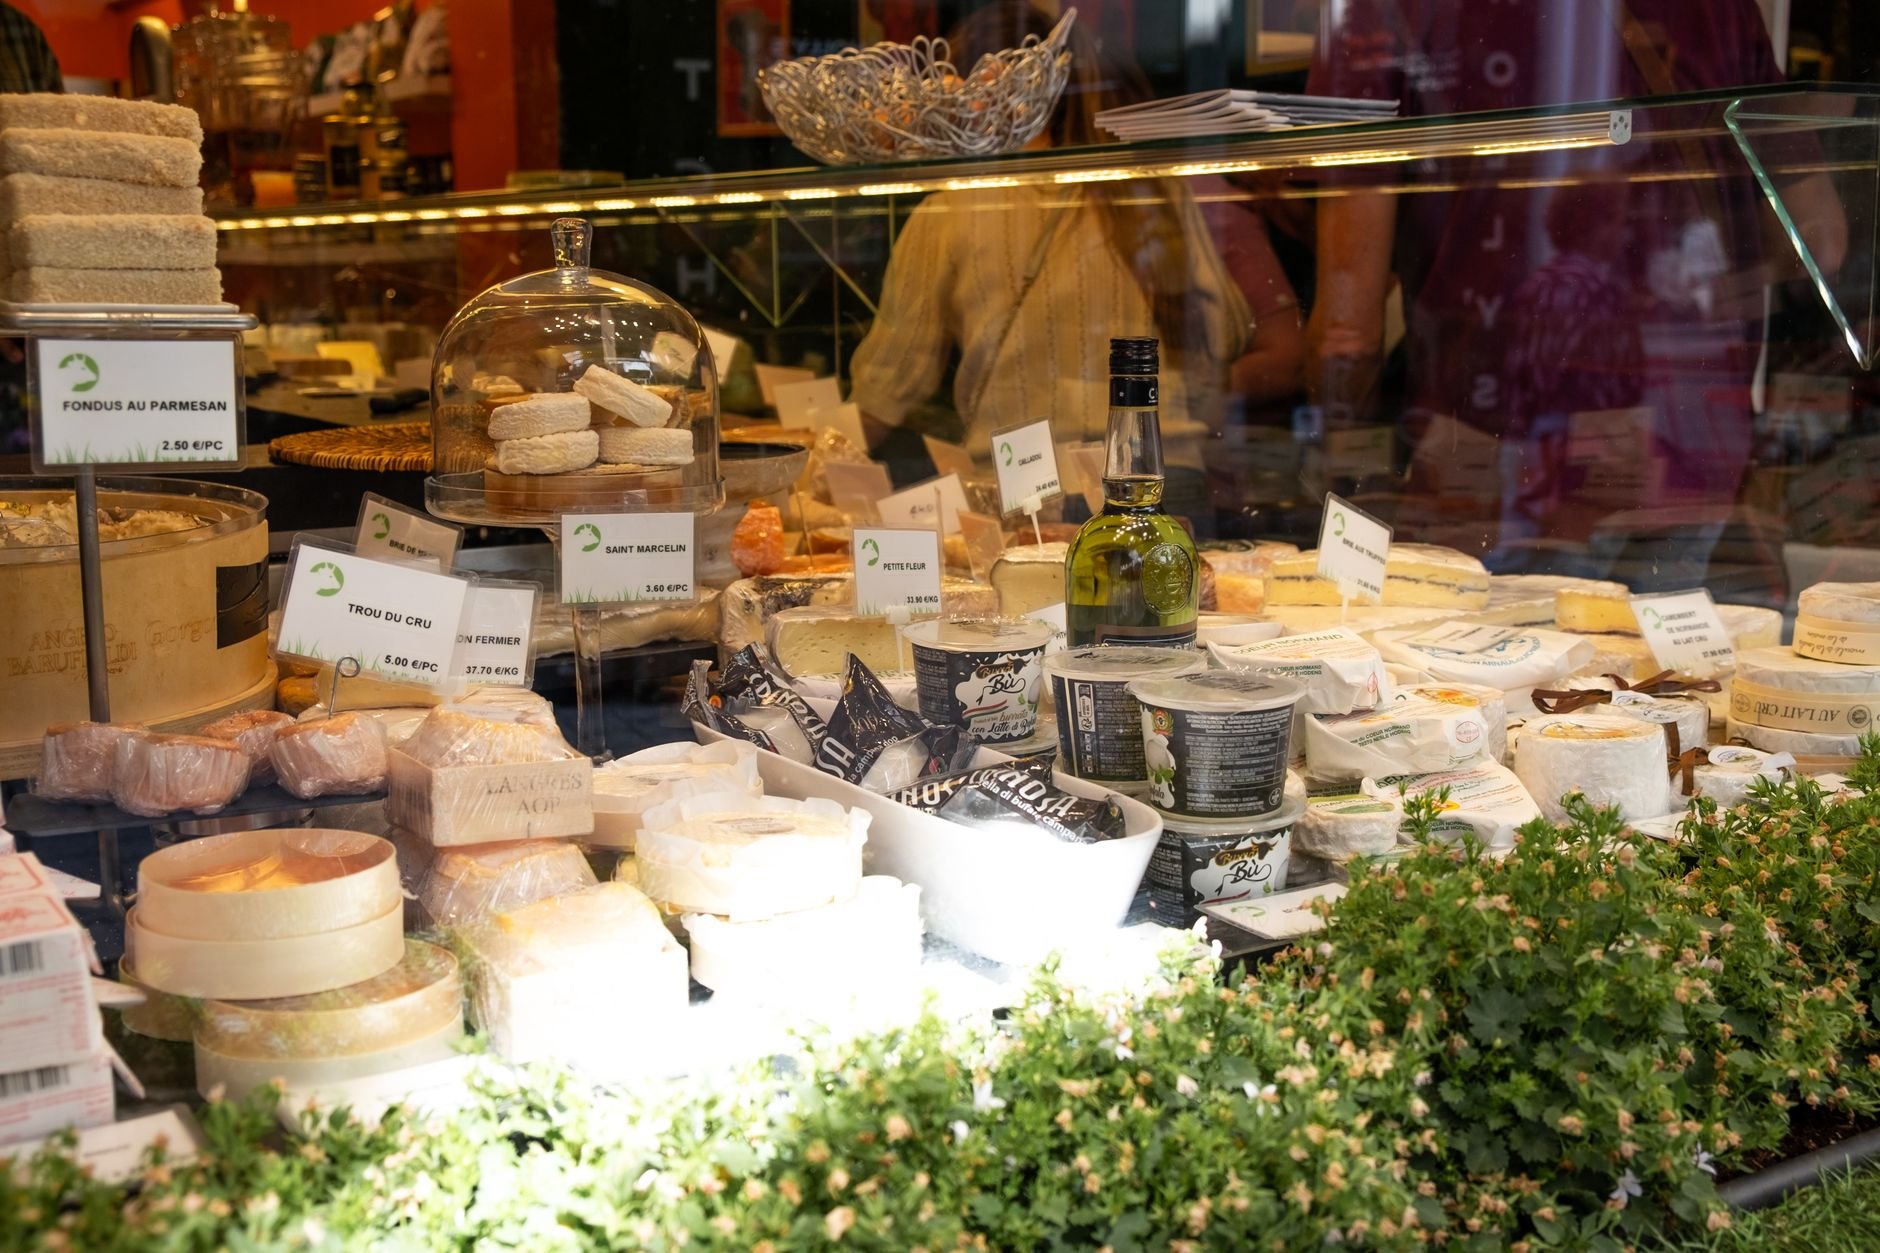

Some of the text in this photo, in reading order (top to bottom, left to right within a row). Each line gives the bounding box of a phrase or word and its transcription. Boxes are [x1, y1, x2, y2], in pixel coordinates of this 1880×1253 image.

[63, 400, 227, 412] FONDUS AU PARMESAN
[162, 440, 223, 451] 2.50 €/PC
[605, 544, 686, 554] SAINT MARCELIN
[883, 562, 927, 571] PETITE FLEUR
[645, 584, 688, 593] 3.60 €/PC
[923, 595, 939, 604] €/KG
[348, 603, 432, 630] TROU DU CRU
[475, 634, 521, 646] FERMIER
[384, 655, 439, 673] 5.00 €/PC
[465, 665, 519, 676] 37.70 €/KG
[1753, 701, 1779, 717] CRU
[1780, 704, 1815, 719] LAIT
[1818, 709, 1841, 723] AU
[988, 721, 1009, 735] Latte
[1011, 723, 1019, 731] di
[1366, 730, 1384, 740] COEUR
[999, 788, 1014, 802] di
